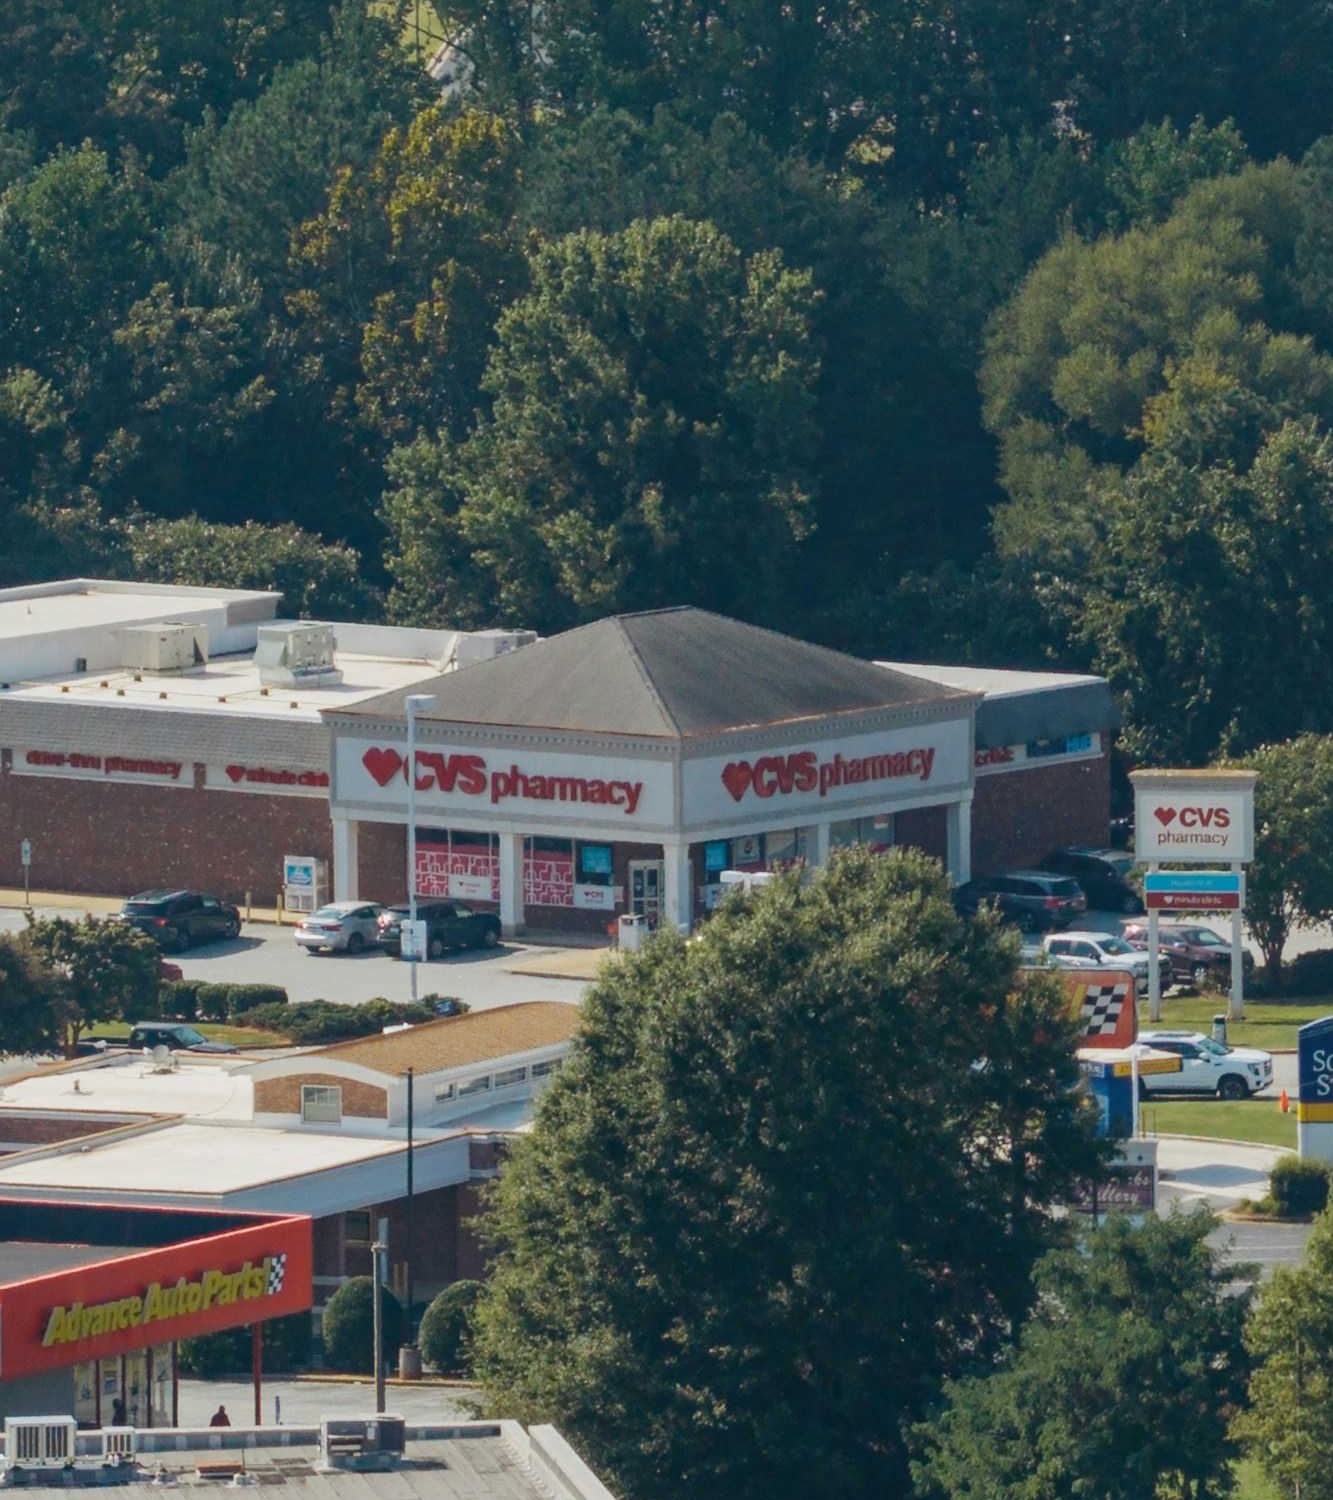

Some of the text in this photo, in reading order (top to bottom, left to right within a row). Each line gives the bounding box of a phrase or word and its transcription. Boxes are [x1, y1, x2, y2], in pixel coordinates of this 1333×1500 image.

[104, 756, 183, 780] pharmacy
[402, 750, 644, 814] CVS pharmacy
[752, 750, 818, 799] CVS
[818, 747, 935, 797] pharmacy
[1178, 807, 1231, 828] CVS
[1158, 831, 1229, 846] pharmacy
[42, 1301, 143, 1346] Advance
[144, 1276, 201, 1323] Auto
